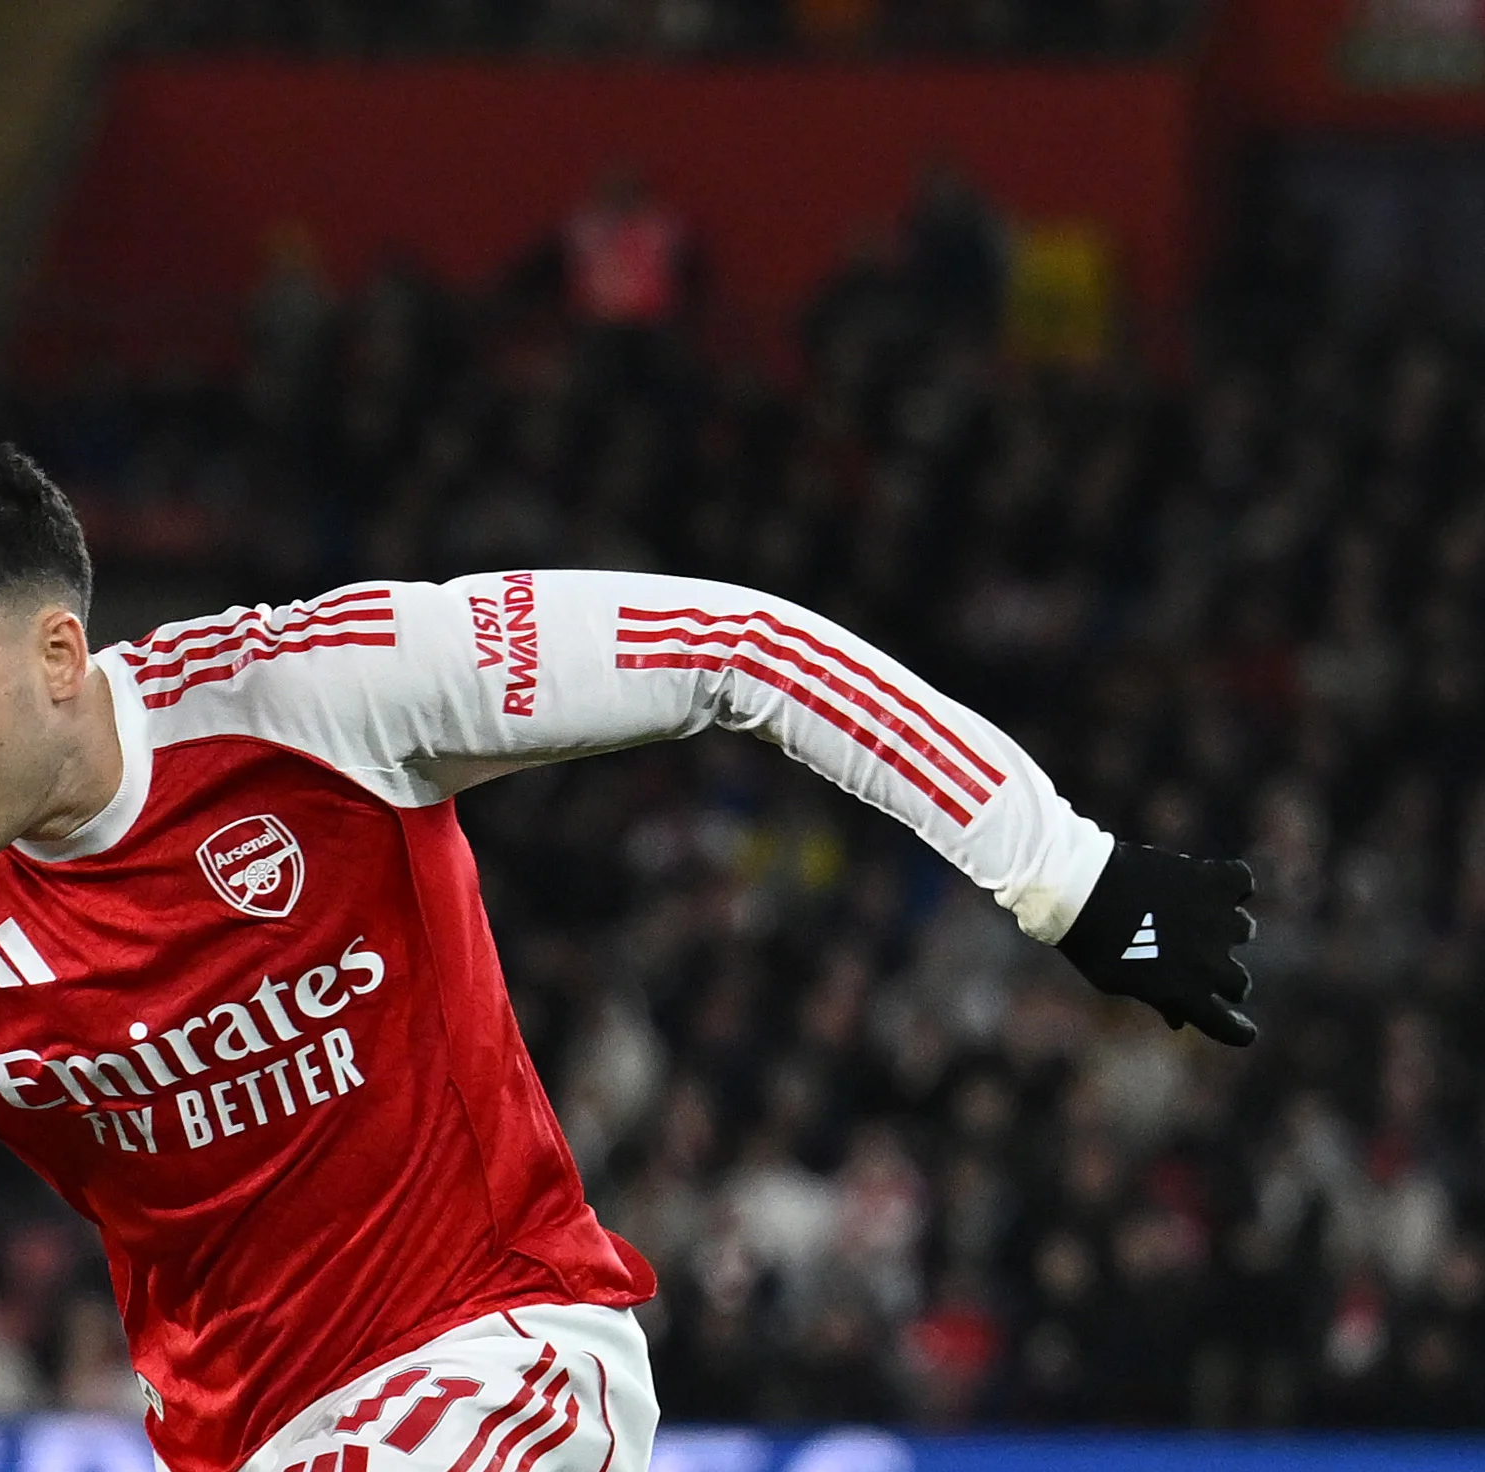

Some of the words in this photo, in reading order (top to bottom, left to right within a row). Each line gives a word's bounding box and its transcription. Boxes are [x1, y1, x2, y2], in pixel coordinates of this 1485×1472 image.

[469, 596, 504, 669] VISIT
[502, 573, 538, 717] RWANDA
[214, 827, 279, 870] Arsenal
[82, 1106, 158, 1154] FLY
[176, 1027, 365, 1150] BETTER
[332, 1366, 485, 1456] 11
